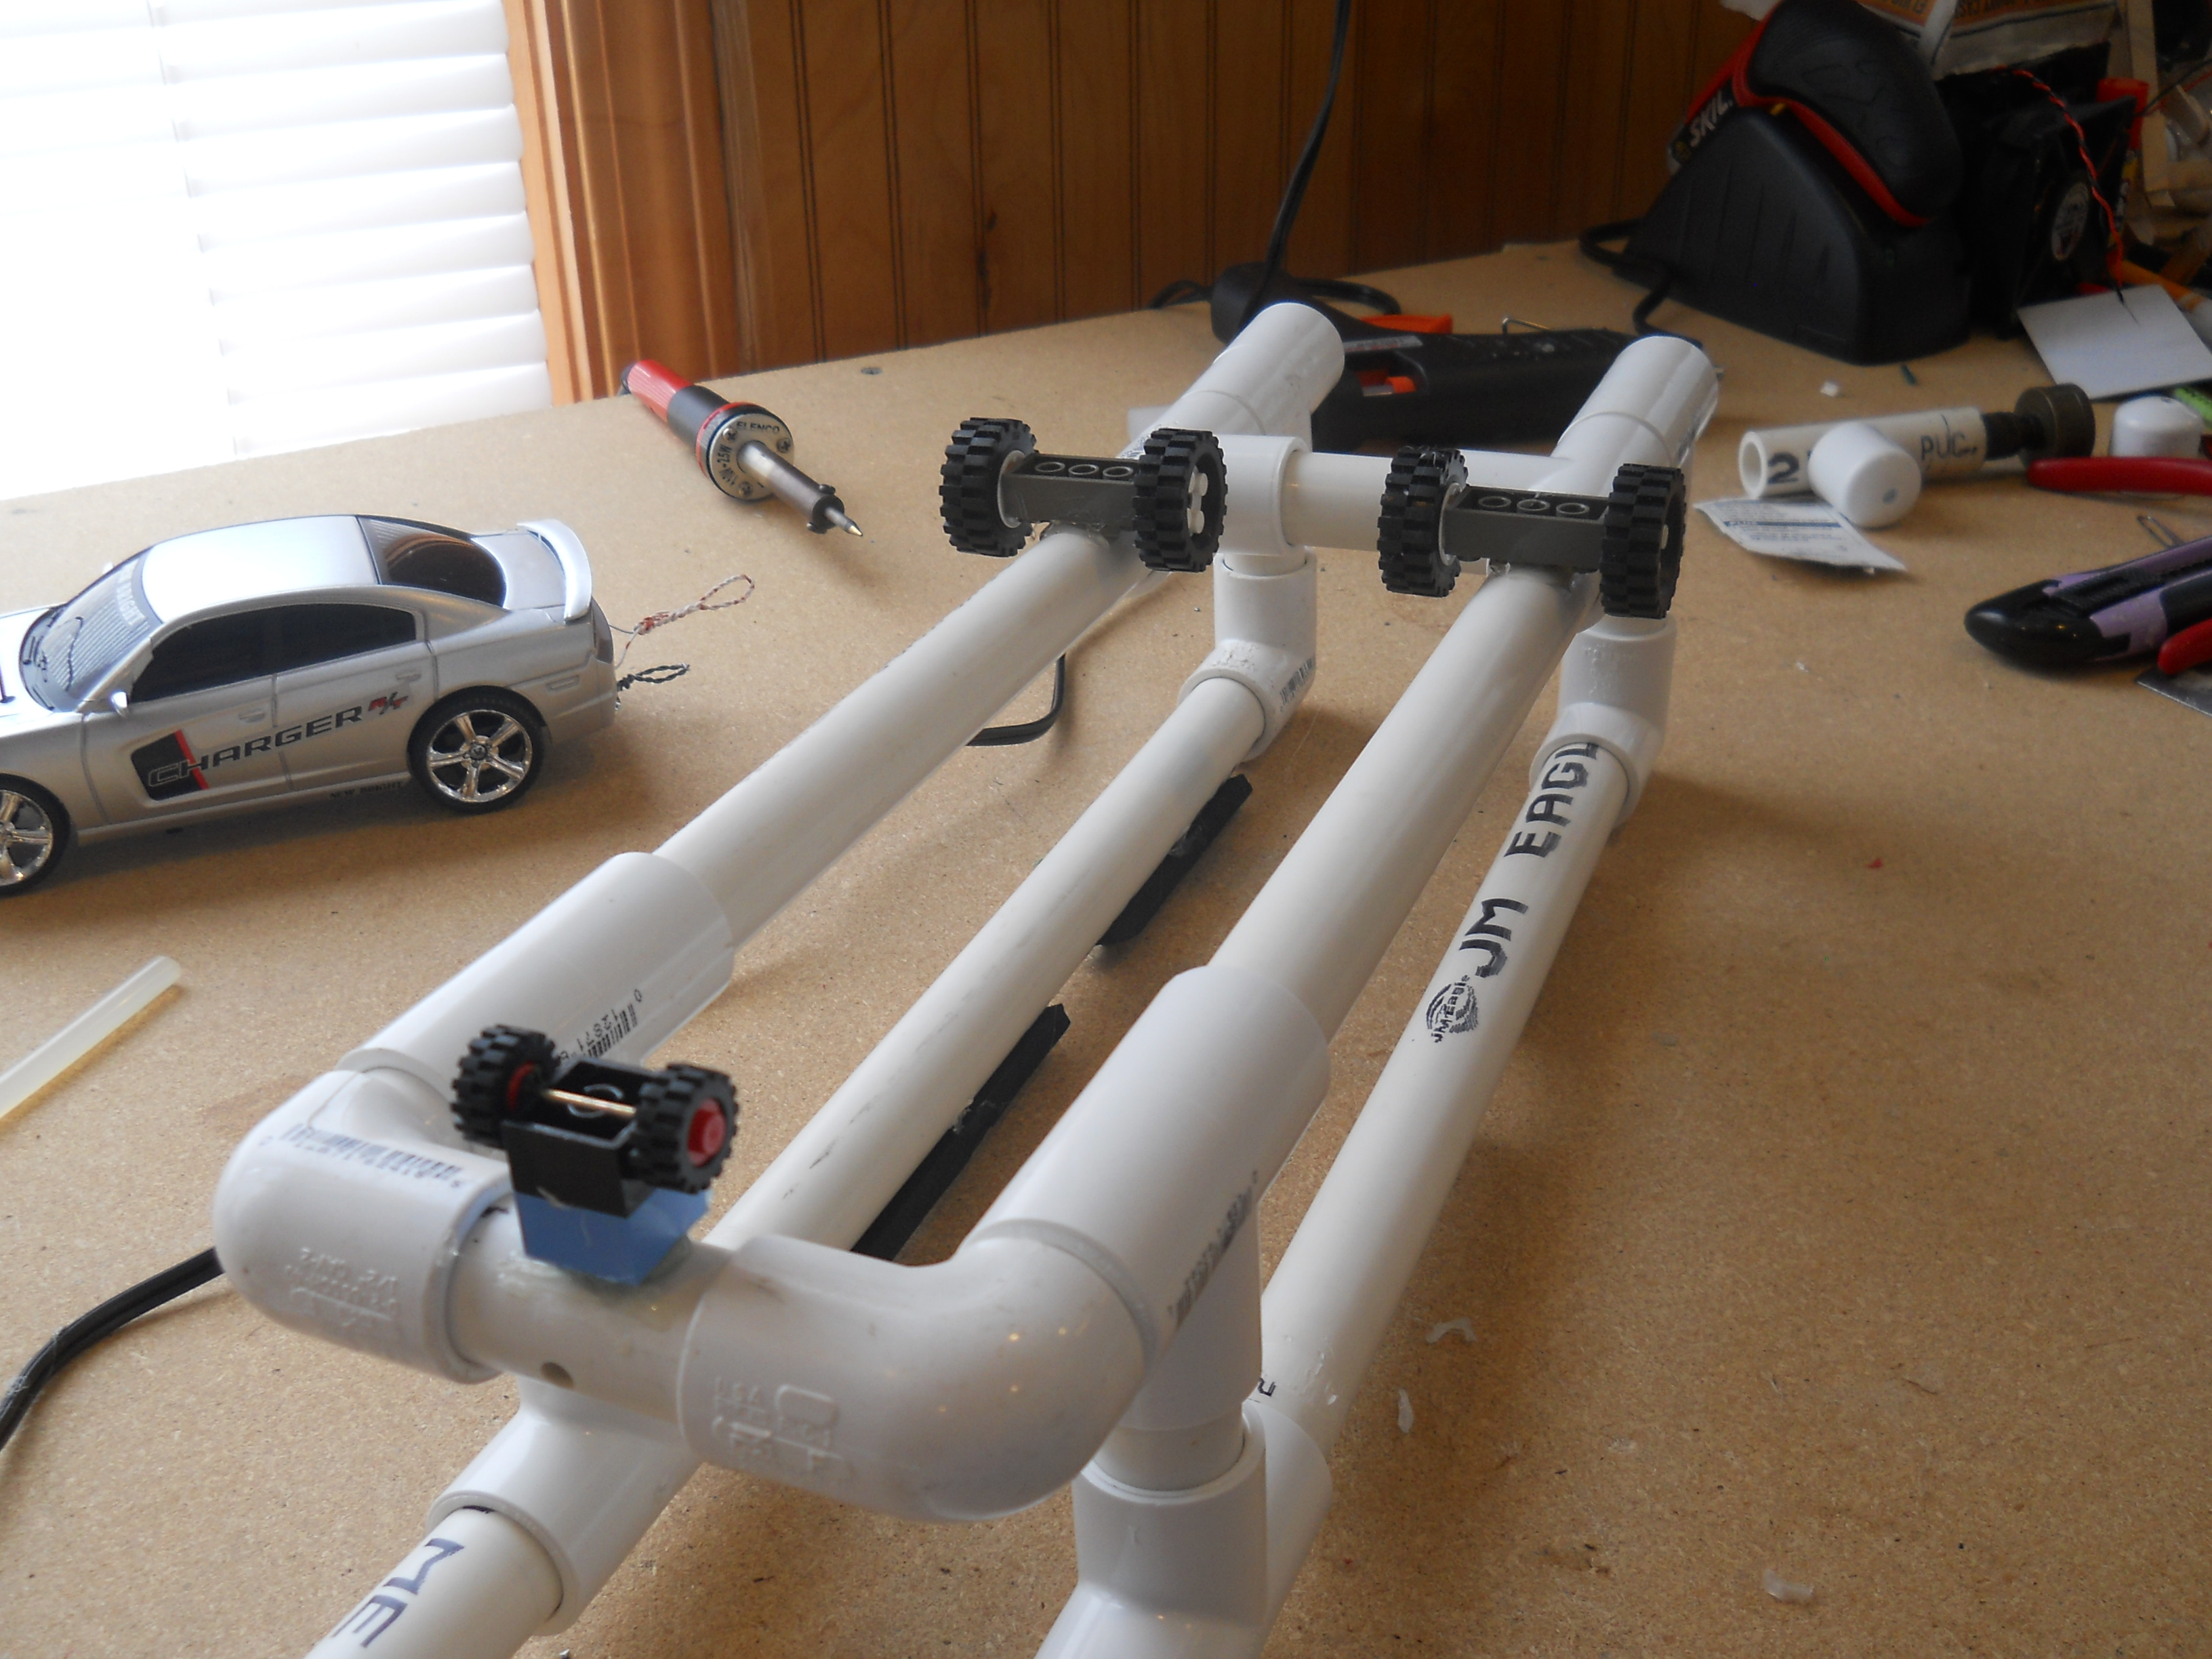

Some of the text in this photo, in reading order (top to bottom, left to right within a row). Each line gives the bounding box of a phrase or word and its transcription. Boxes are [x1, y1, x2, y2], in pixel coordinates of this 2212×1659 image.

[1690, 90, 1729, 147] SKIL
[737, 421, 780, 434] ELENCO
[148, 705, 363, 788] CHARGER
[1459, 897, 1529, 979] JM
